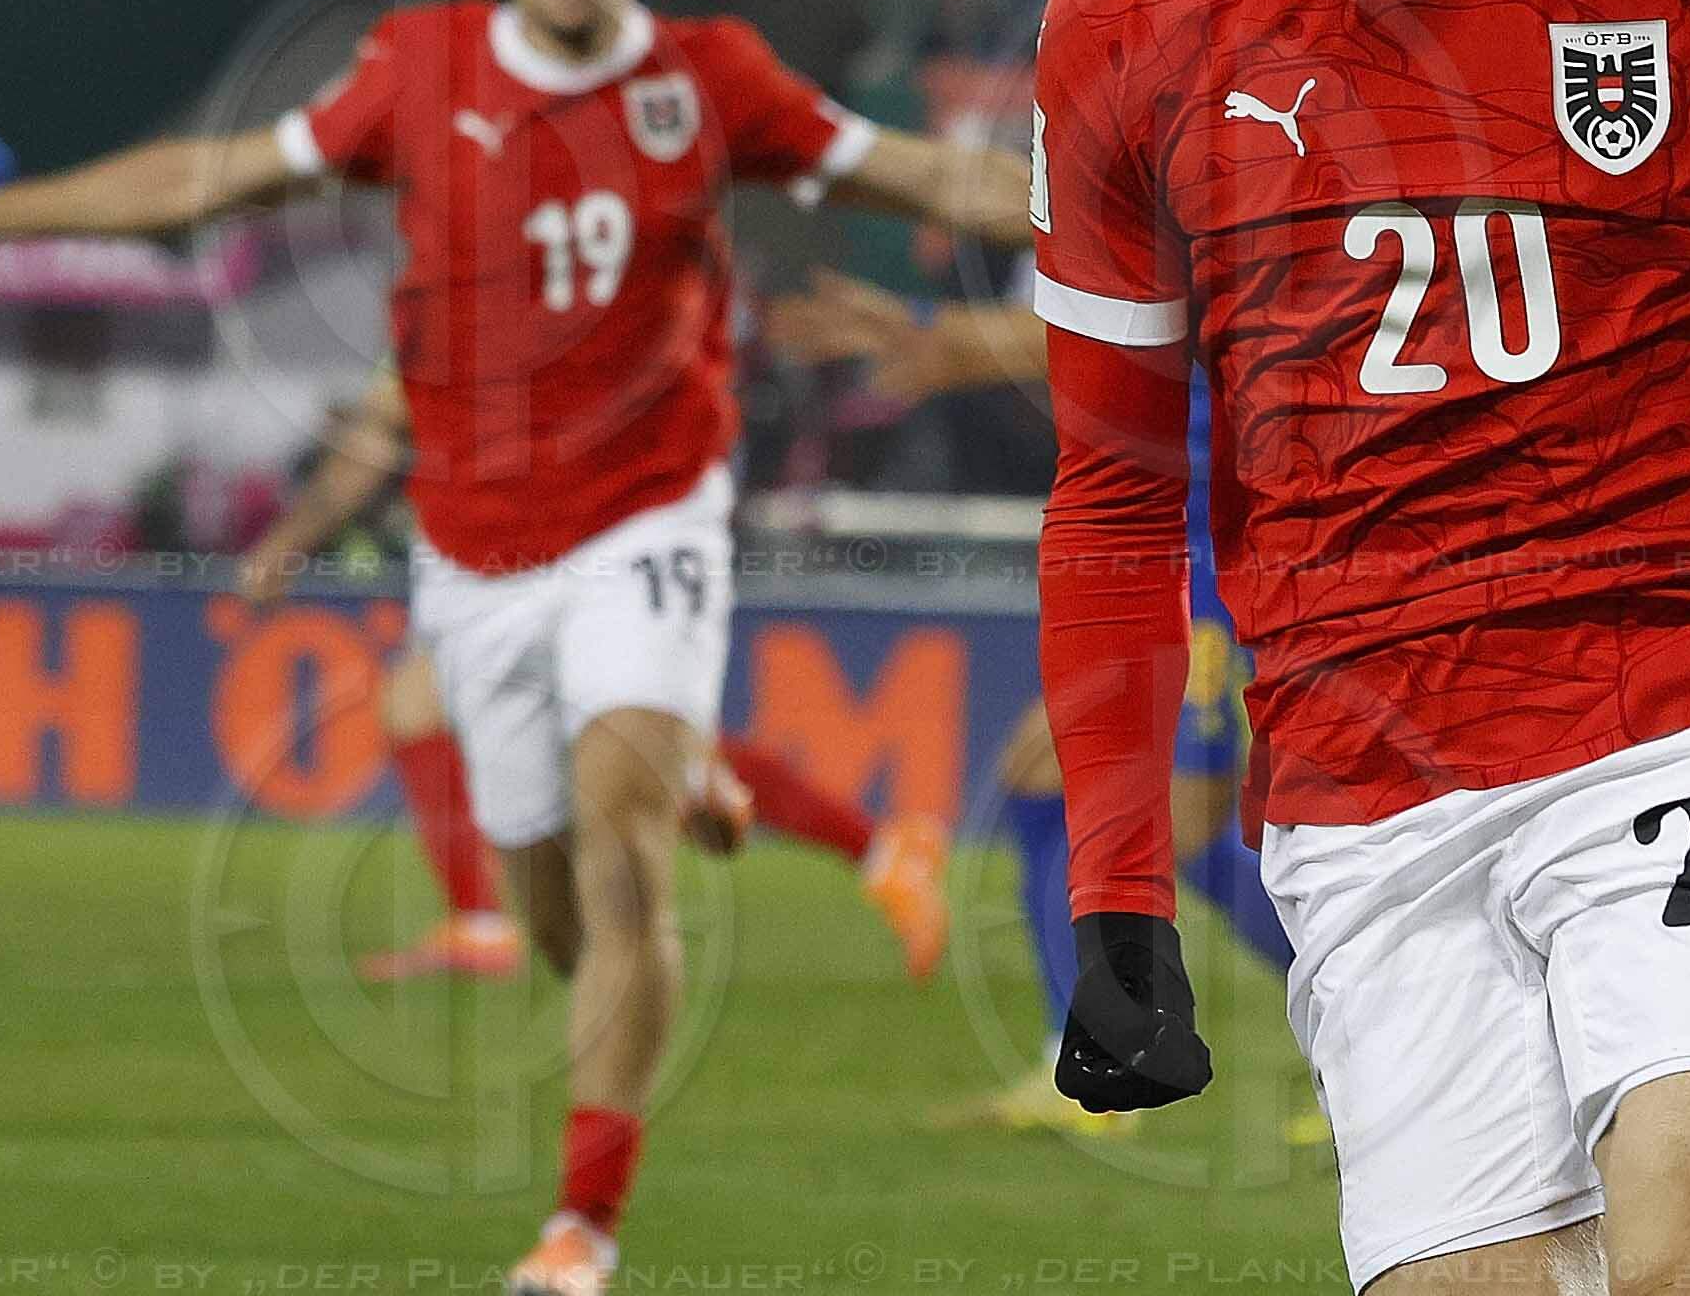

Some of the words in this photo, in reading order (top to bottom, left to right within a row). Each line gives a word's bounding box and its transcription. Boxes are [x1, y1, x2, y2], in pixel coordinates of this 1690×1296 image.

[1584, 31, 1632, 46] ÖFB
[521, 188, 634, 311] 19
[1343, 196, 1561, 395] 20
[629, 546, 707, 616] 19
